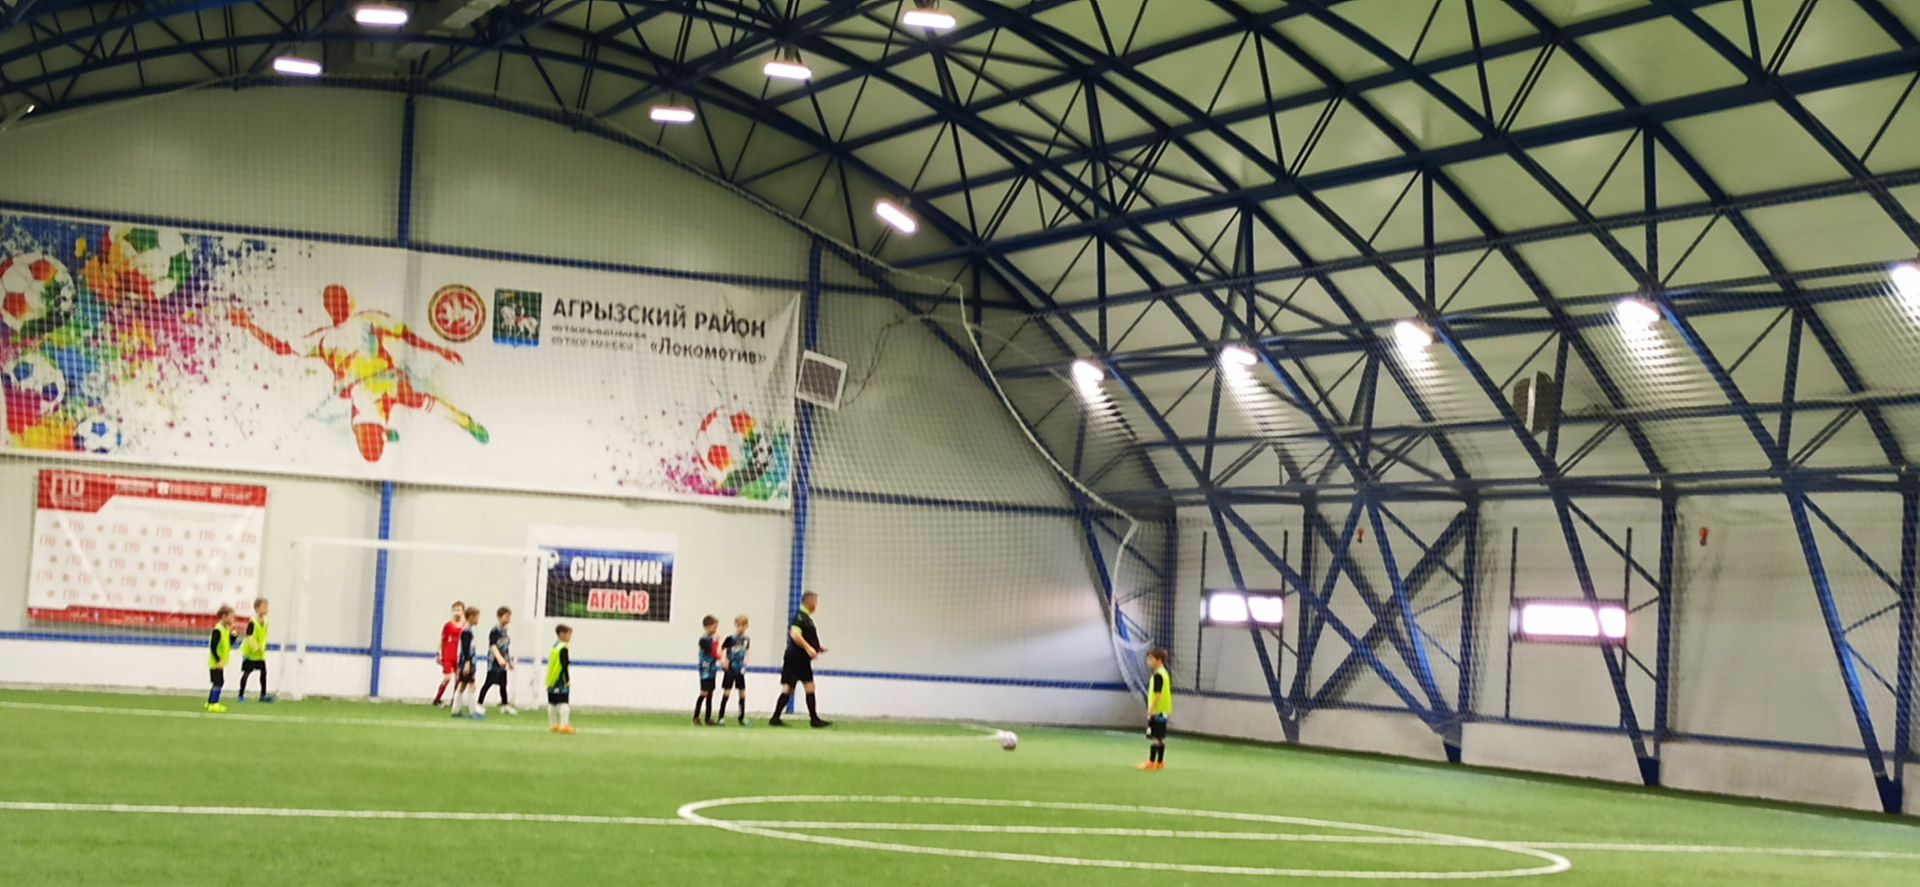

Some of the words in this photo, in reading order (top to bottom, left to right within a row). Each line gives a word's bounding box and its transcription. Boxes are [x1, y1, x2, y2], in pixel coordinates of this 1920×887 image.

[553, 298, 686, 329] АГРЫЗСКИЙ
[694, 309, 766, 338] РАЙОН
[570, 556, 663, 585] СПУТНИК
[587, 588, 649, 615] АГРЫЗ
